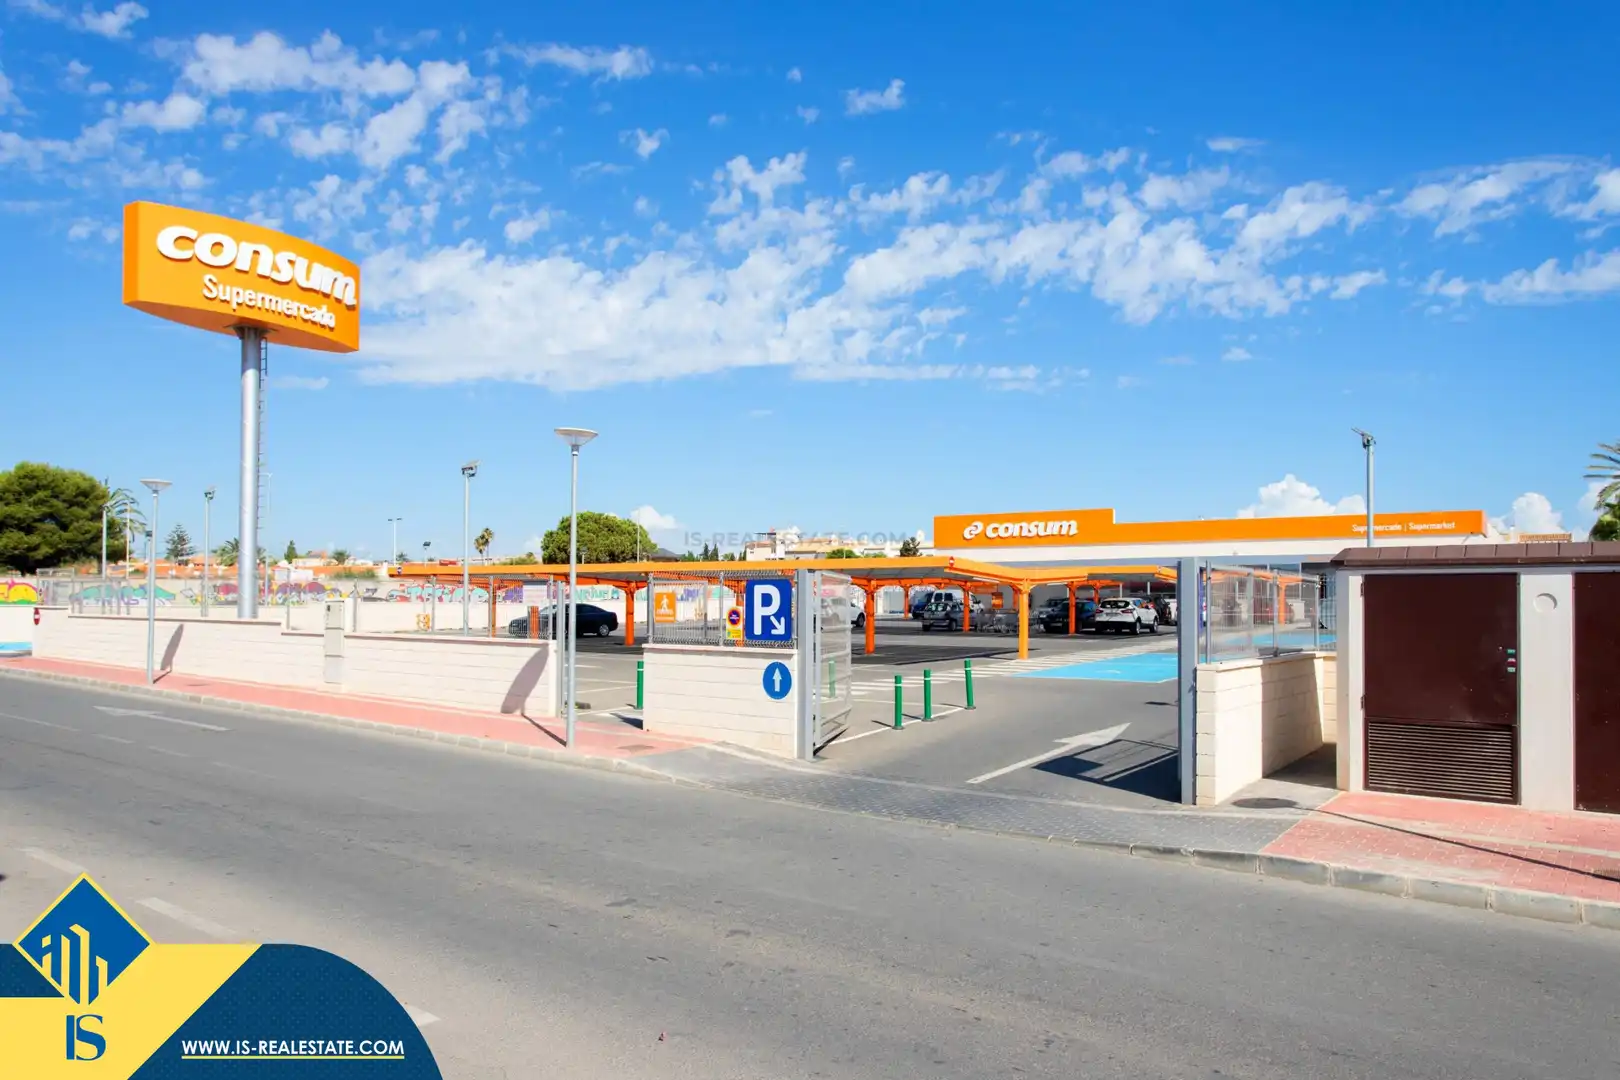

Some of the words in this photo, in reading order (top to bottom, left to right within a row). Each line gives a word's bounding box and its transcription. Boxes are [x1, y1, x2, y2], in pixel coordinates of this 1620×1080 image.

[156, 225, 357, 306] consum
[202, 274, 336, 329] Supermercado
[985, 519, 1079, 538] consum
[753, 584, 781, 636] P
